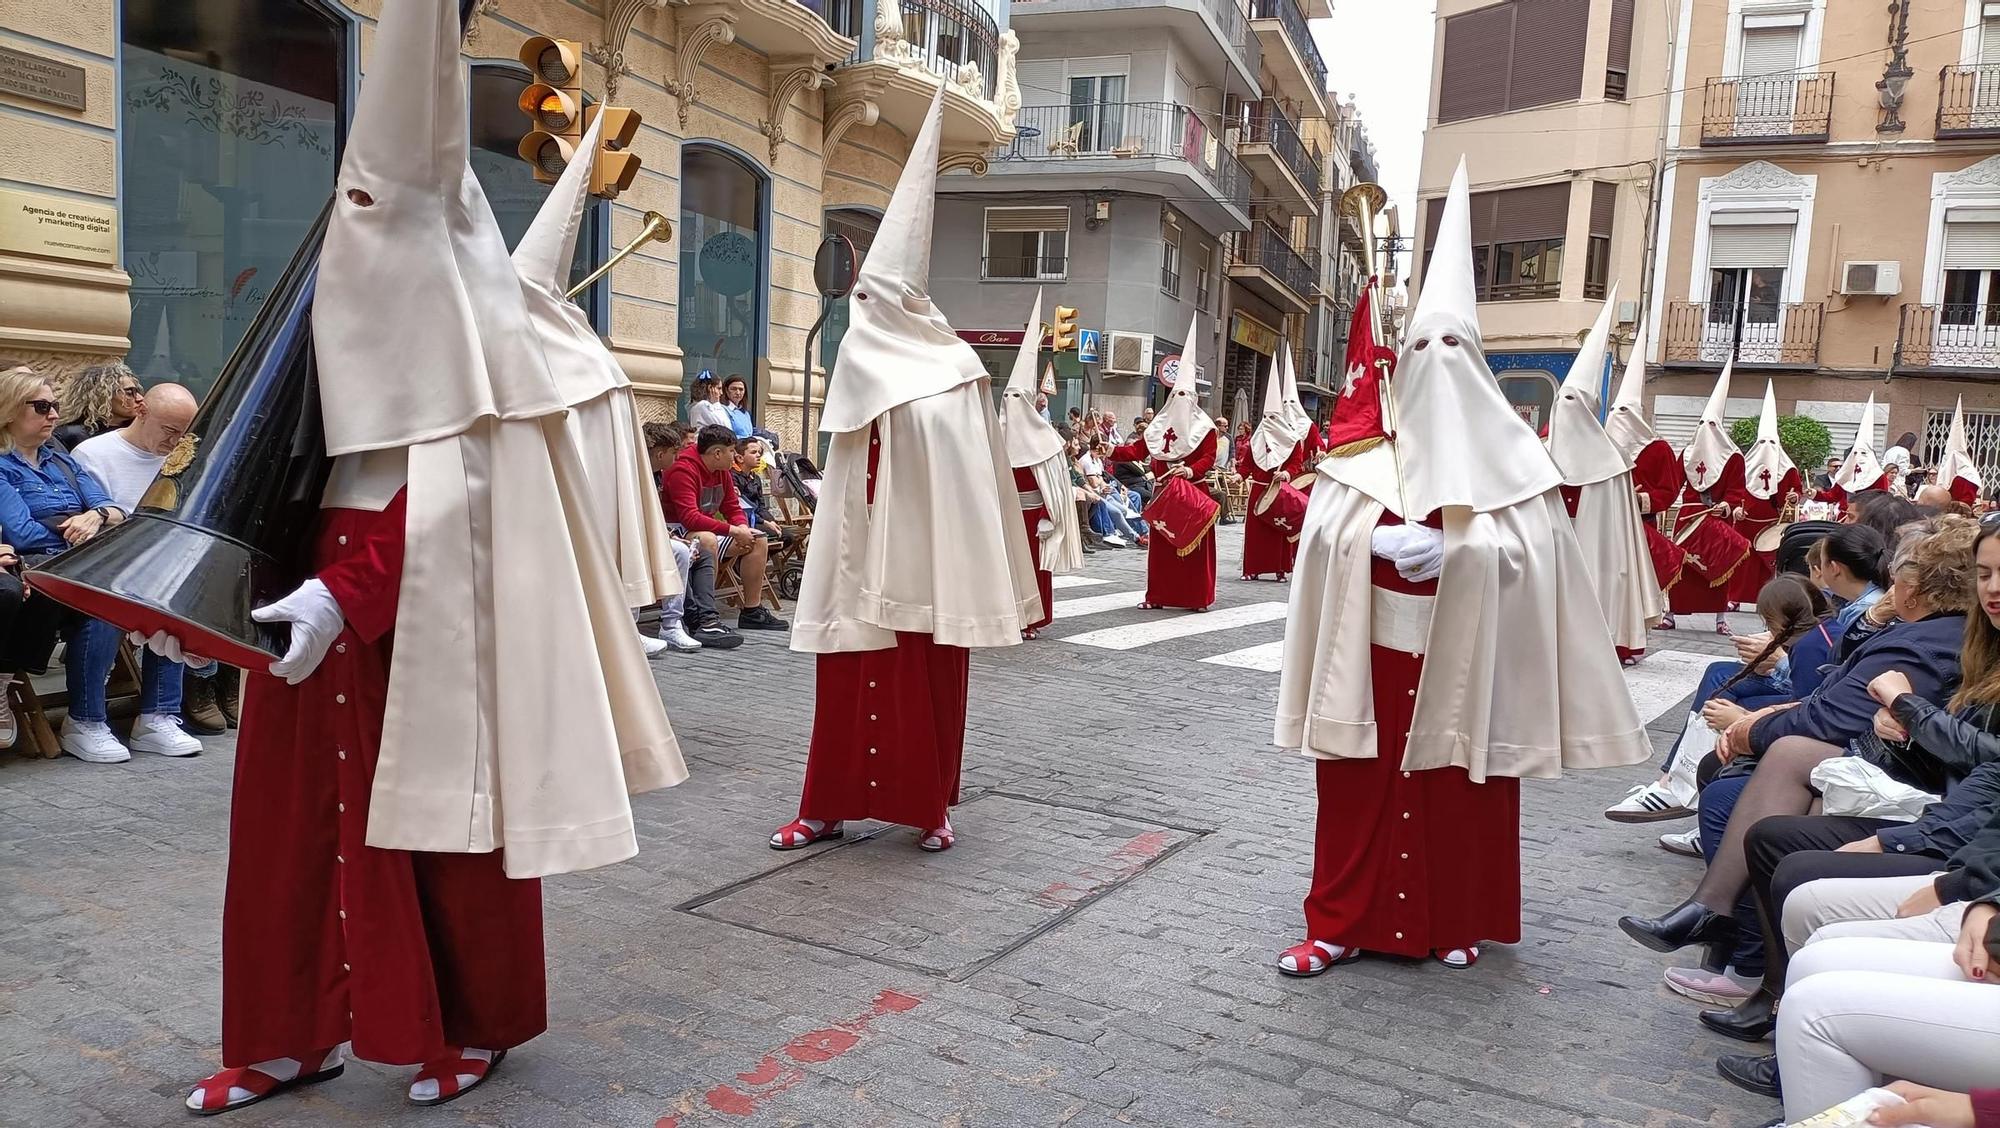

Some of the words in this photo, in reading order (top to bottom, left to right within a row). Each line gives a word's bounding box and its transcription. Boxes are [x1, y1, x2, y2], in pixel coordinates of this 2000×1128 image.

[22, 204, 55, 216] Agencia
[56, 210, 67, 218] de
[68, 212, 110, 226] creatividad
[38, 216, 43, 224] y
[45, 217, 85, 230] marketing
[86, 223, 110, 233] digital
[44, 240, 111, 254] nuevecomanueve.com
[979, 332, 1010, 343] Bar
